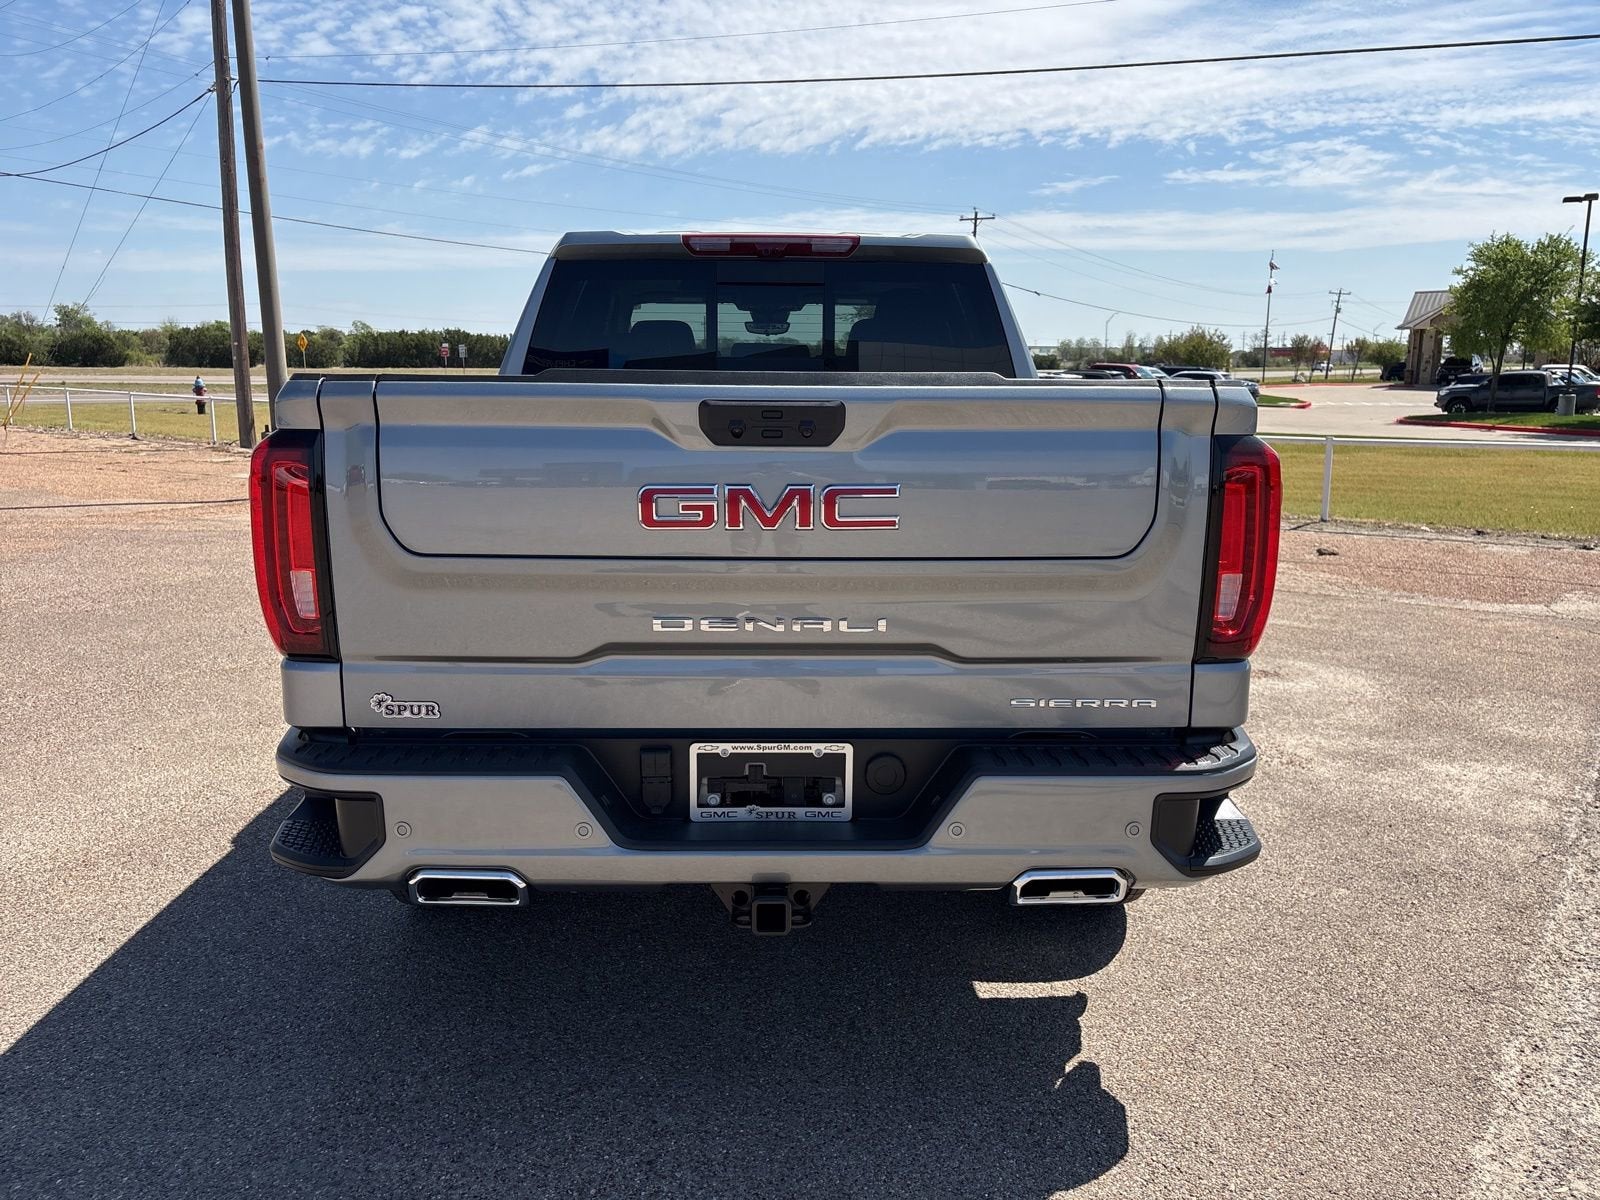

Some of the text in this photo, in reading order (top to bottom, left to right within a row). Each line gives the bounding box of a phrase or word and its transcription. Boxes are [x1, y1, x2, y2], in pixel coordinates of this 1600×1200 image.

[637, 484, 901, 531] GMC
[652, 616, 888, 633] DENALI
[1010, 699, 1157, 708] SIERRA
[385, 704, 436, 715] SPUR
[731, 744, 812, 752] www.SpurGM.com
[700, 811, 842, 820] GMC SPUR GMC
